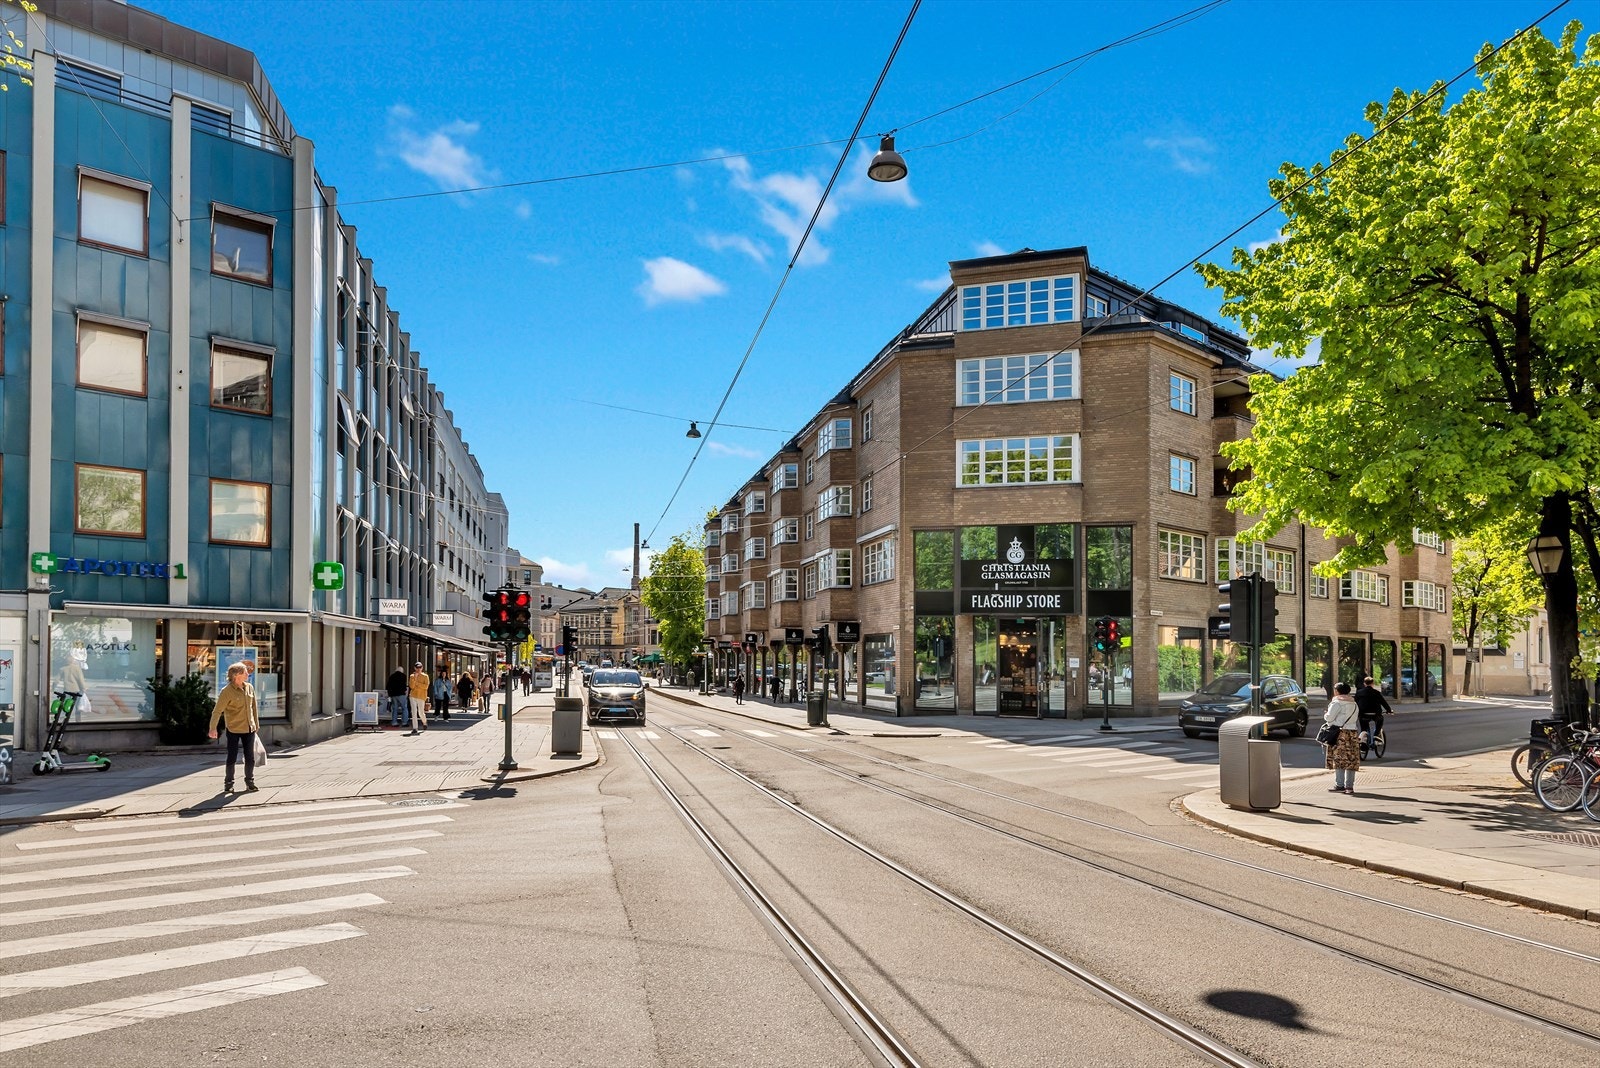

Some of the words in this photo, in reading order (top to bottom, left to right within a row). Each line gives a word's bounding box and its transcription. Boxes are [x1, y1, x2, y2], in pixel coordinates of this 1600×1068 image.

[1009, 551, 1022, 559] CG
[63, 557, 171, 580] APOTEK
[173, 563, 187, 579] 1
[981, 563, 1051, 572] CHRISTIANIA
[981, 571, 1051, 580] GLASMAGASIN
[381, 601, 406, 609] WARM
[971, 594, 1023, 608] FLAGSHIP
[1026, 594, 1061, 608] STORE
